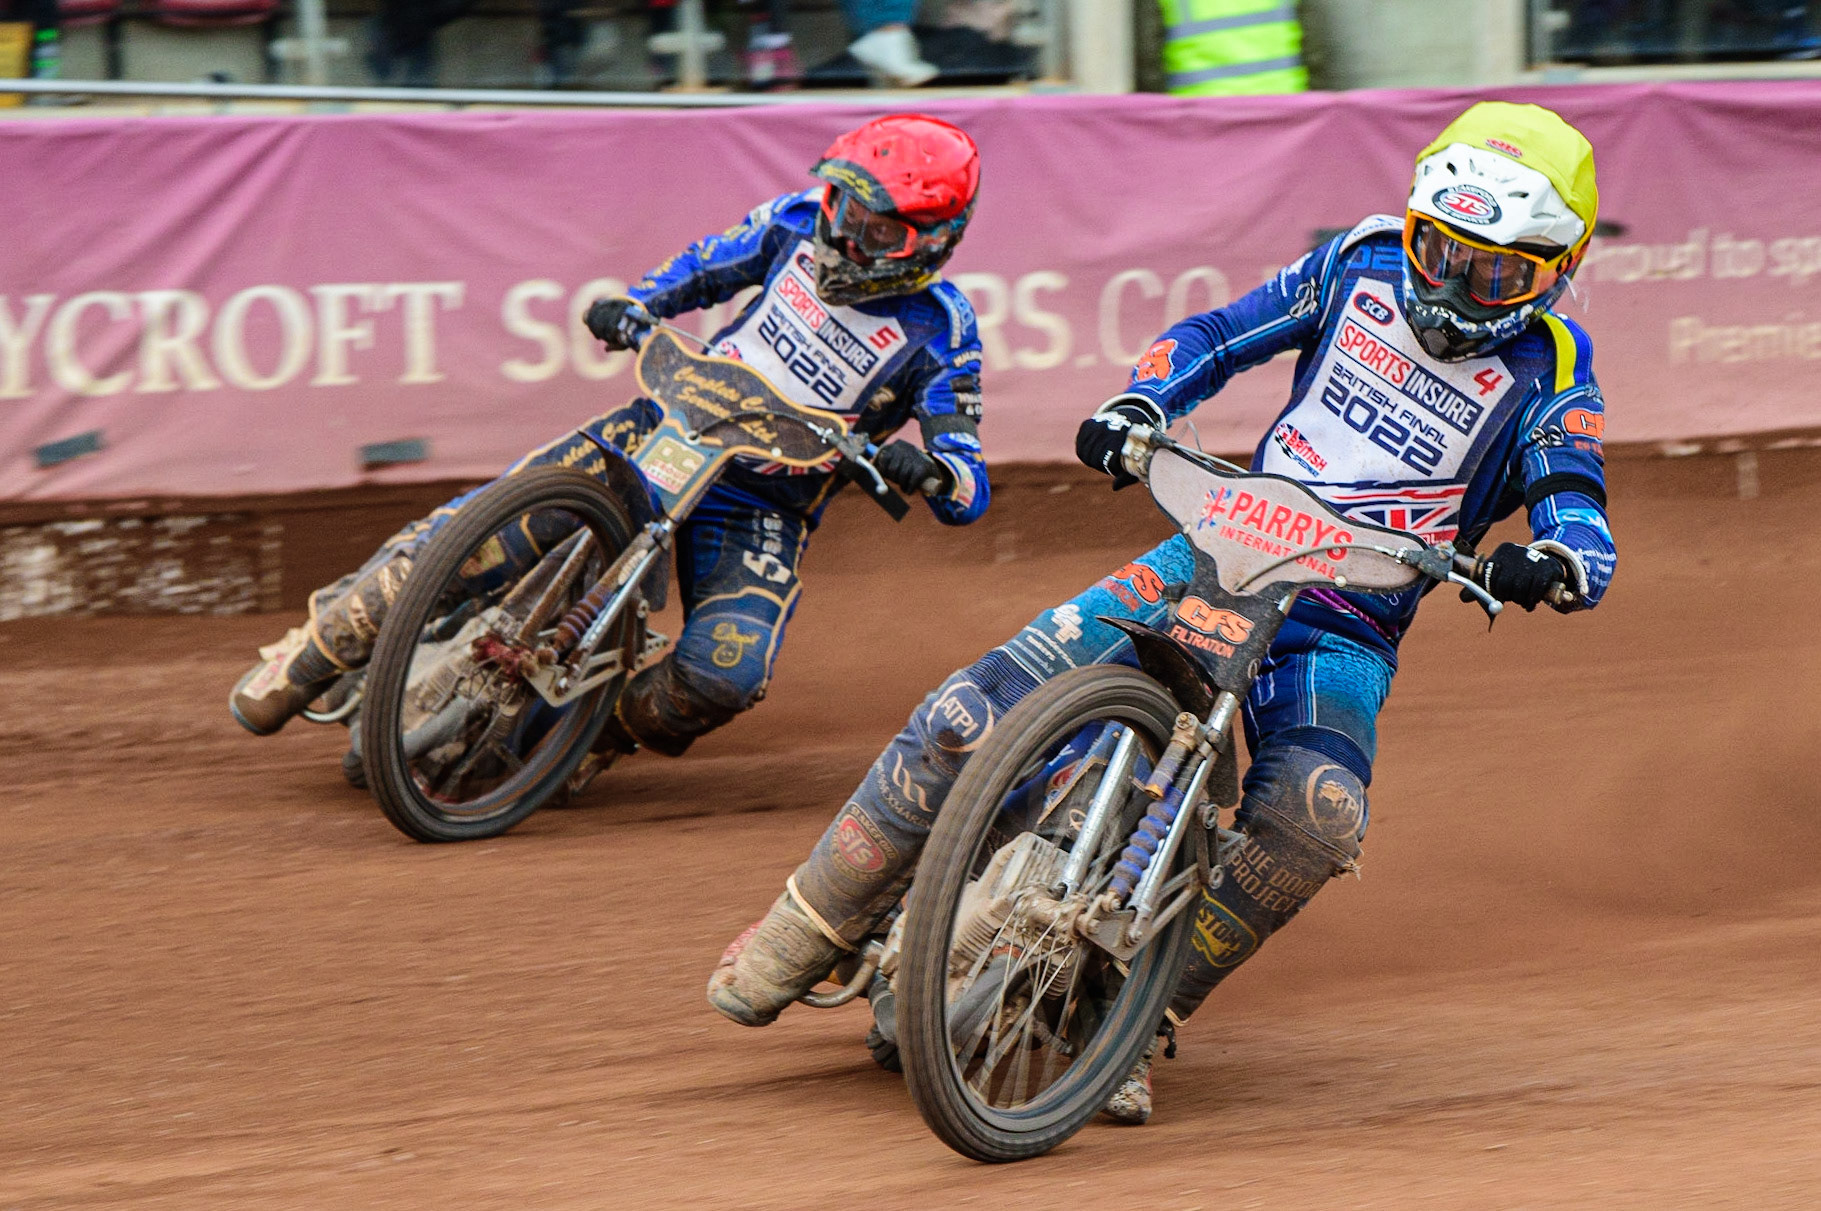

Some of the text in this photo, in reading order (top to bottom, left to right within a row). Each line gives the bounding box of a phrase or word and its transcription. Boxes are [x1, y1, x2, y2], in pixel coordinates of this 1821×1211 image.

[1444, 193, 1490, 216] STS
[1711, 232, 1763, 280] to
[779, 277, 876, 374] SPORTS INSURE
[1361, 298, 1389, 321] SCB
[760, 314, 843, 405] 2022
[771, 303, 848, 386] BRITISH FINAL
[868, 325, 900, 350] 5
[1339, 324, 1478, 431] SPORTS INSURE
[1473, 367, 1503, 396] 4
[1320, 374, 1444, 478] 2022
[1332, 361, 1448, 449] BRITISH FINAL
[1286, 428, 1327, 471] BRITISH
[1227, 489, 1354, 562] PARRYS
[1219, 525, 1336, 580] INTERNATONAL
[1170, 624, 1236, 659] FILTRATION
[1175, 596, 1255, 645] CFS
[940, 696, 979, 738] ATPI
[839, 825, 876, 866] STS
[1228, 852, 1302, 912] PROJECT
